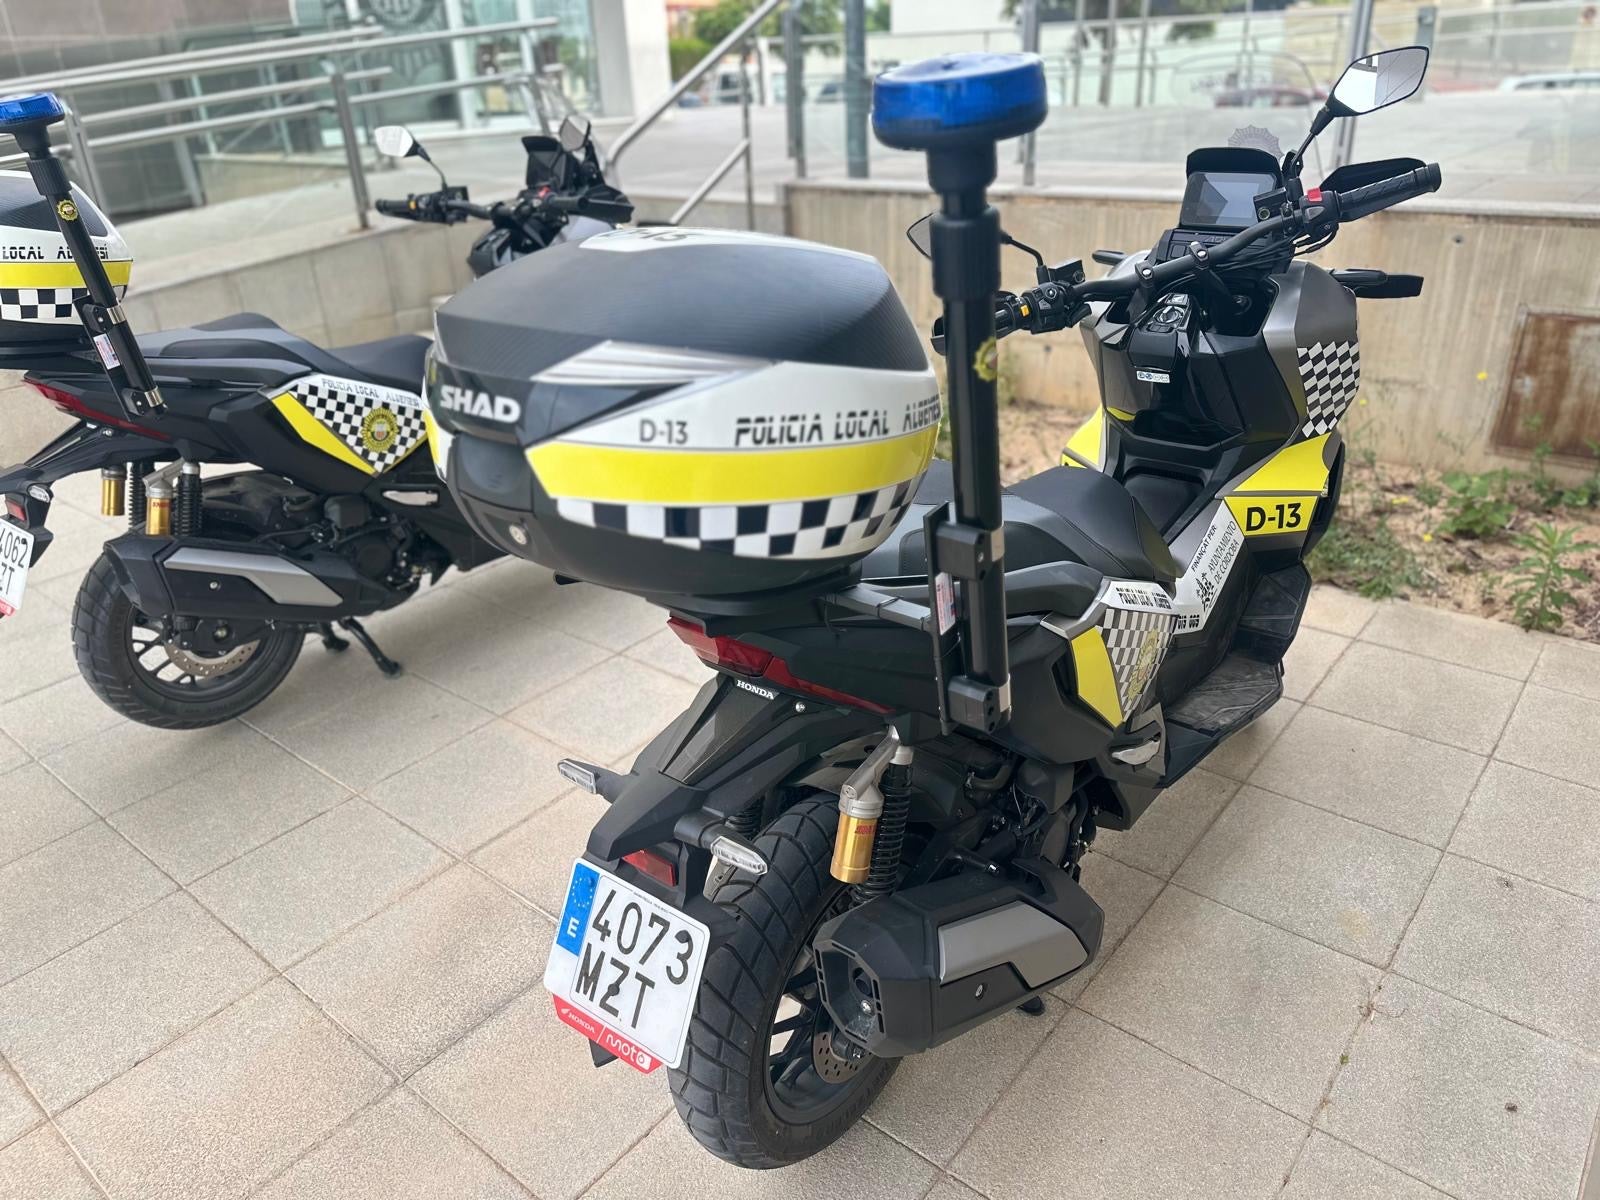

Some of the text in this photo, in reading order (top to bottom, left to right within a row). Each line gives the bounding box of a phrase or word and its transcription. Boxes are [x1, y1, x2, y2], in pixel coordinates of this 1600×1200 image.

[2, 246, 44, 260] LOCAL
[439, 384, 521, 424] SHAD
[639, 419, 688, 445] D-13
[735, 413, 823, 446] POLICIA
[834, 410, 889, 440] LOCAL
[1246, 502, 1301, 531] D-13
[1190, 525, 1217, 572] FINANÇAT PER
[1208, 520, 1237, 574] AYUNTAMIENTO
[1213, 571, 1223, 585] DE
[736, 679, 774, 700] HONDA
[567, 916, 580, 938] E
[592, 889, 694, 985] 4073
[575, 942, 656, 1030] MZT
[567, 1012, 596, 1034] HONDA
